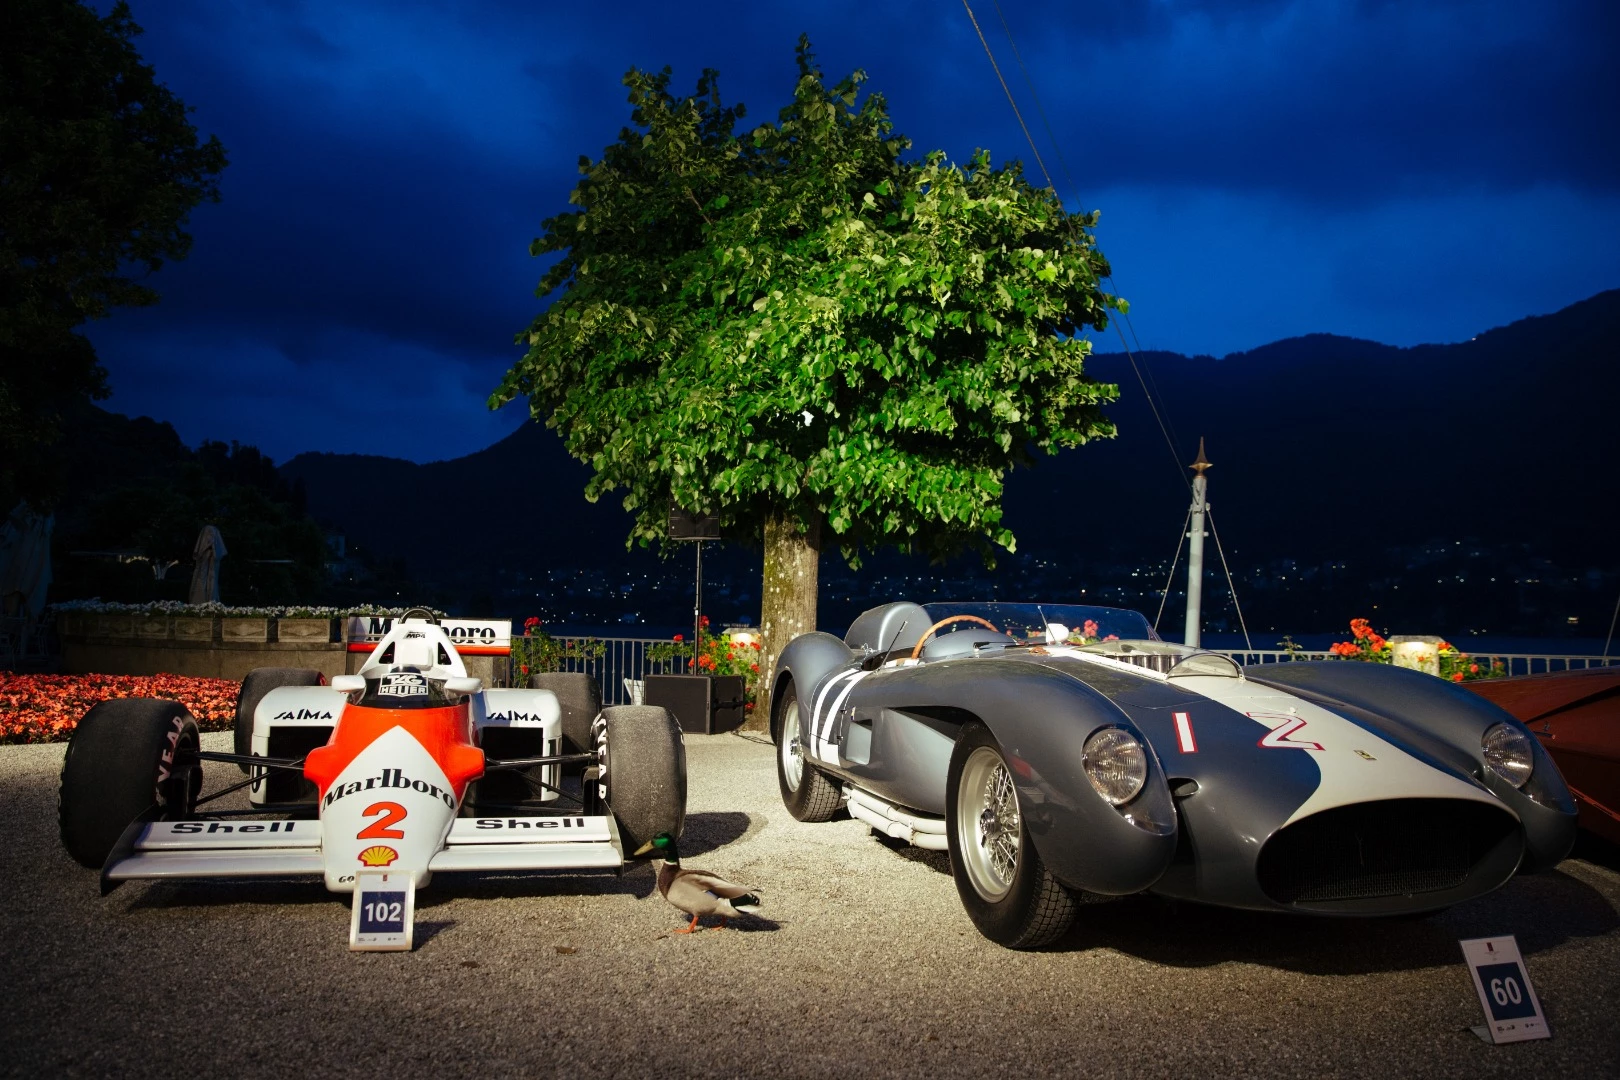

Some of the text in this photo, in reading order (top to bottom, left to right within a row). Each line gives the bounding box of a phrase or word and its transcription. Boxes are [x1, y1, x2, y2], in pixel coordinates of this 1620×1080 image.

[366, 617, 496, 645] Mboro
[386, 673, 424, 685] TAG
[381, 685, 427, 695] HEUER
[322, 768, 456, 811] Marlboro
[170, 821, 296, 834] Shell
[356, 801, 408, 840] 2
[476, 818, 585, 830] Shell
[365, 902, 402, 922] 102
[1490, 976, 1522, 1007] 60
